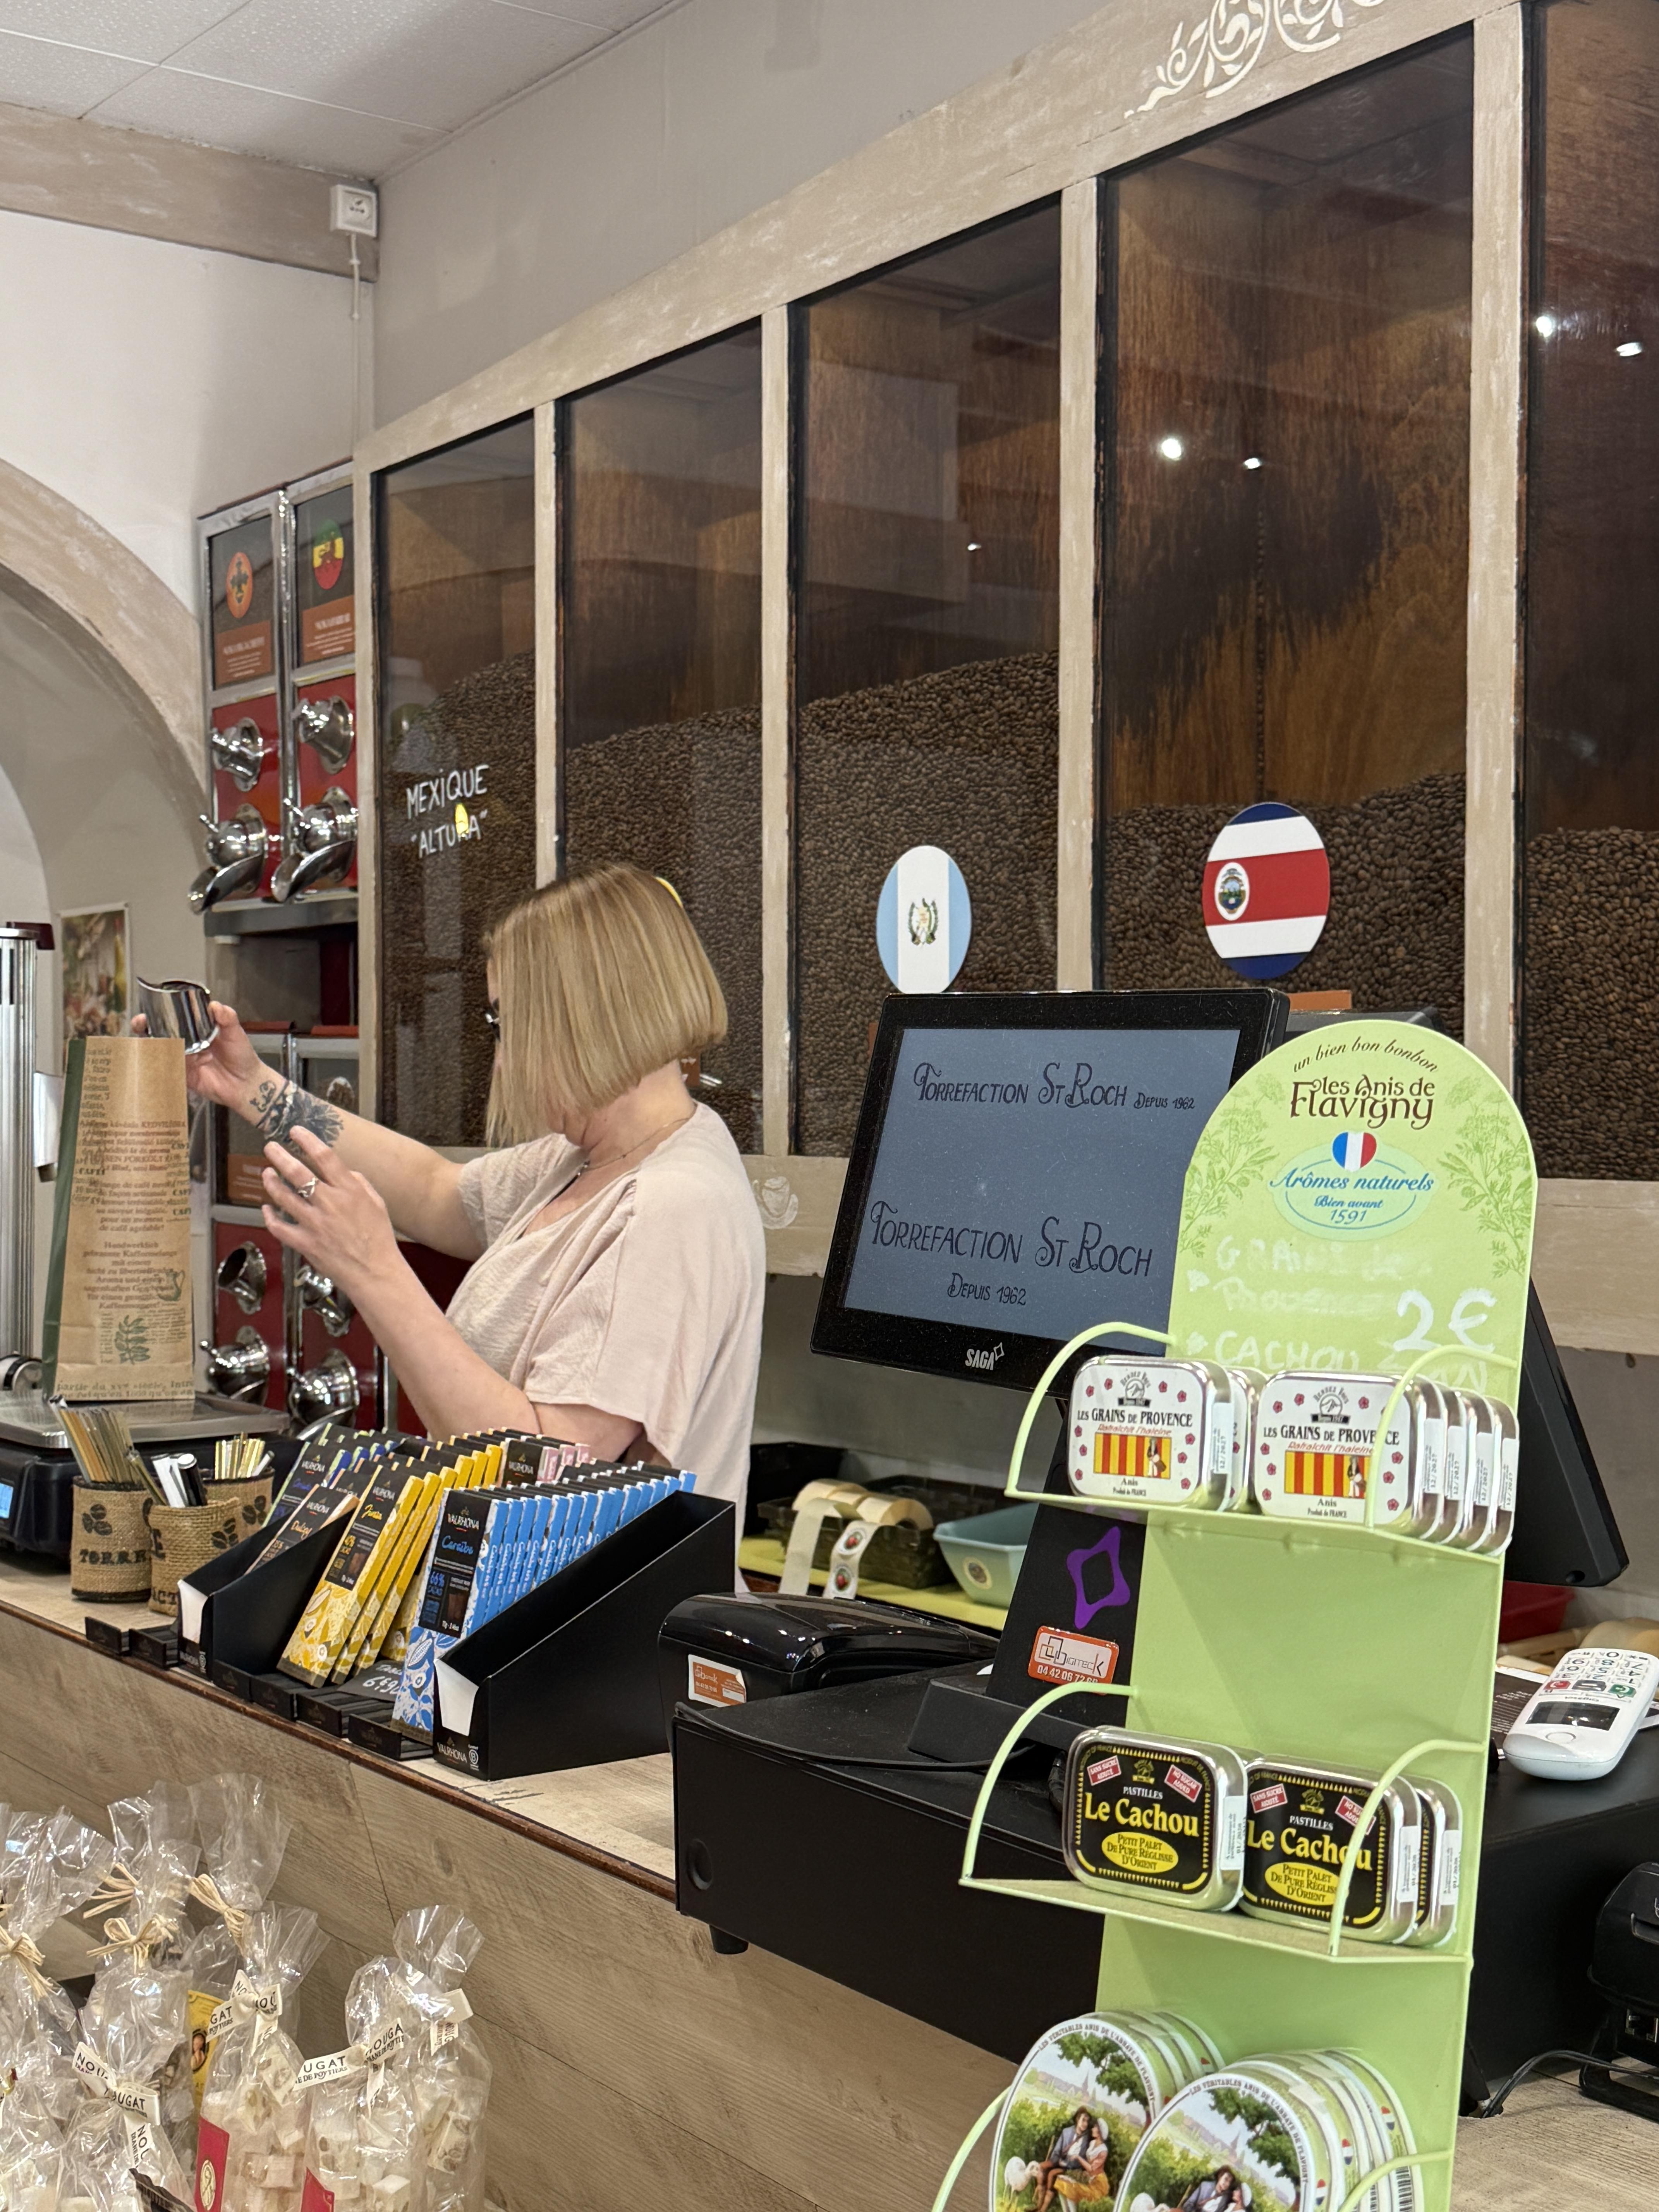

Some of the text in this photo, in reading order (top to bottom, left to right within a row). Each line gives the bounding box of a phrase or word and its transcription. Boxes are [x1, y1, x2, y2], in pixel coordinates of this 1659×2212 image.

[406, 764, 489, 819] MEXIQUE
[410, 809, 488, 859] "ALTUA"
[1294, 1036, 1438, 1072] un bien bon bonbon
[914, 1061, 1029, 1105] TORREFACTION
[1064, 1062, 1127, 1108] ROCH
[1172, 1096, 1195, 1109] 1962
[1322, 1074, 1435, 1099] les Anis de
[1290, 1078, 1434, 1130] Flavigny
[1270, 1167, 1434, 1191] Arômes naturels
[1314, 1195, 1384, 1208] Bien avant
[1330, 1209, 1367, 1225] 1591
[871, 1200, 1024, 1265] TORREFACTION
[1069, 1221, 1153, 1277] ROCH
[996, 1285, 1027, 1306] 1962
[965, 1347, 994, 1371] SAGA
[1077, 1408, 1193, 1427] LES GRAINS DE PROVENCE
[1264, 1424, 1400, 1446] LES GRAINS DE PROVECE
[1121, 1477, 1139, 1486] Anis
[1317, 1498, 1337, 1508] Anis
[1037, 1664, 1048, 1675] 04
[1049, 1668, 1061, 1679] 42
[1061, 1671, 1073, 1681] 06
[436, 1742, 467, 1764] VALRHONA
[1123, 1786, 1163, 1800] PASTILLES
[1085, 1792, 1110, 1822] Le
[1115, 1798, 1199, 1837] Cachou
[1289, 1815, 1334, 1831] PASTILLES
[1117, 1834, 1162, 1851] PETIT PALET
[1247, 1820, 1274, 1851] Le
[1107, 1841, 1118, 1852] DE
[1118, 1845, 1139, 1857] PURE
[1121, 1854, 1158, 1870] D'ORIENT
[1271, 1872, 1283, 1883] DE
[1284, 1876, 1307, 1889] PURE
[1282, 1863, 1332, 1884] PETIT PALET
[1287, 1886, 1326, 1903] D'ORIENT
[210, 2006, 233, 2025] GAT
[1038, 2039, 1049, 2051] LES
[303, 2055, 346, 2073] UGAT
[314, 2065, 348, 2080] POYTIERS
